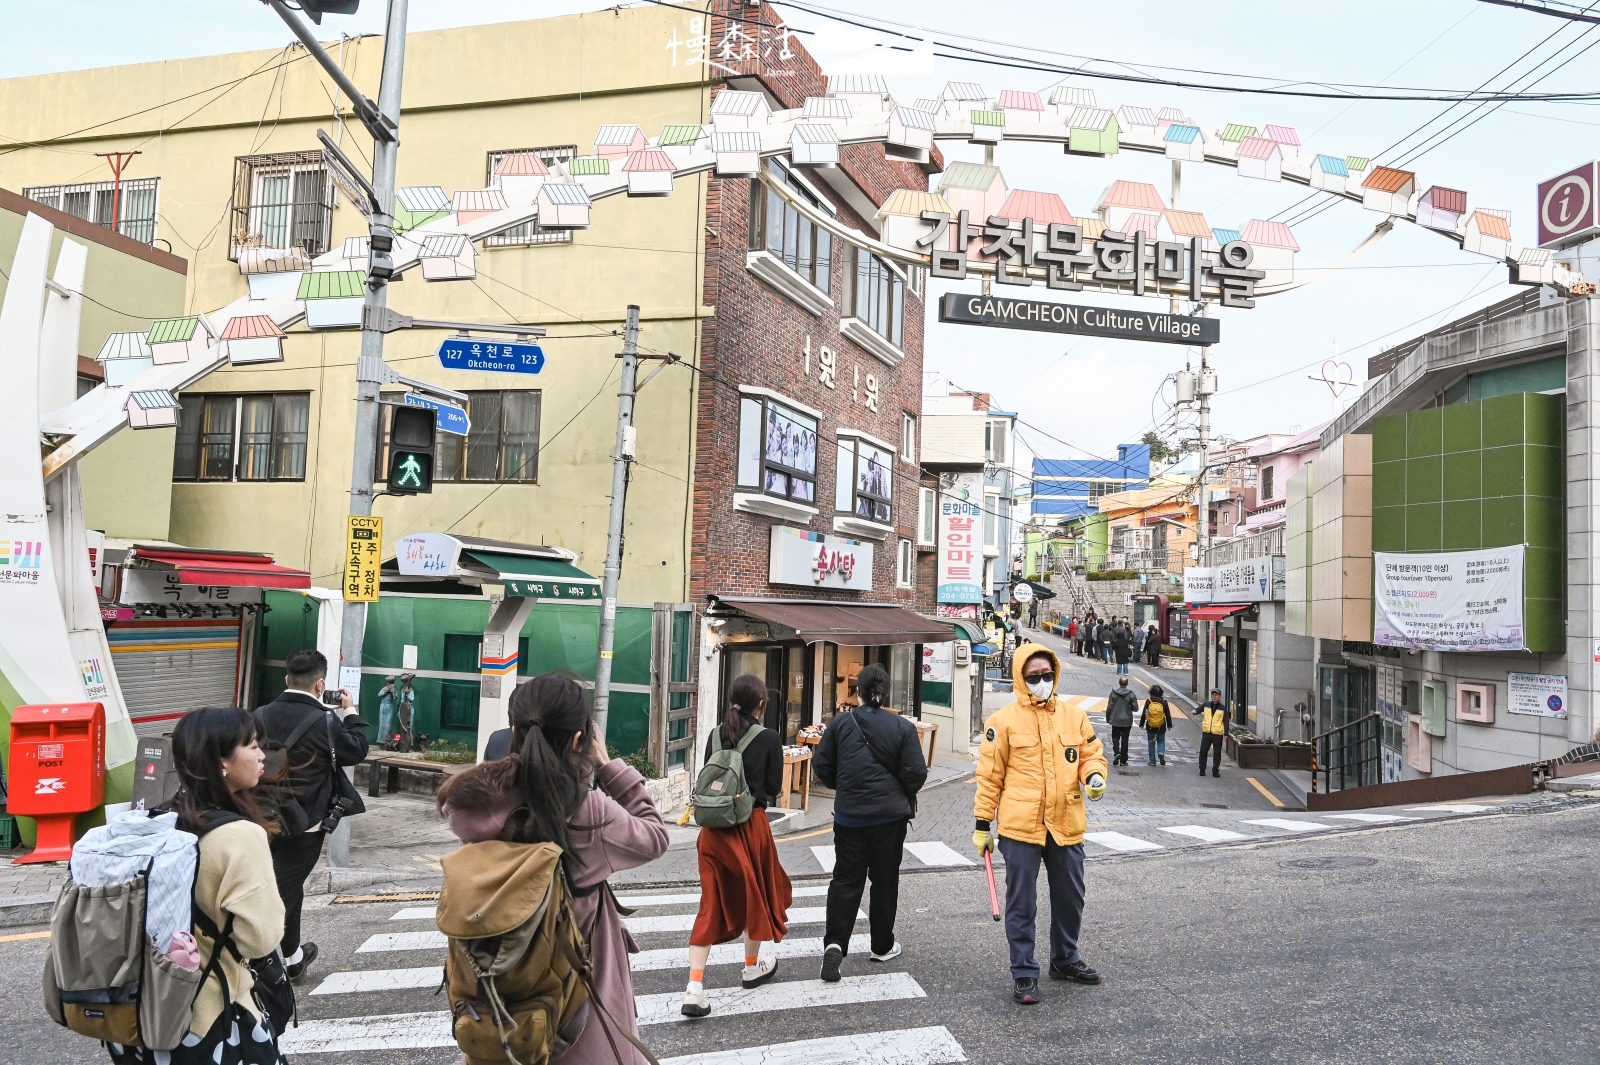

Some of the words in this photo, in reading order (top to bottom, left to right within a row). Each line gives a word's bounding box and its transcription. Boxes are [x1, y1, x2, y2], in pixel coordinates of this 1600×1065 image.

[916, 208, 1266, 308] 감천문화마을
[967, 297, 1079, 326] GAMCHEON
[1082, 308, 1144, 332] Culture
[1147, 315, 1202, 337] Village
[446, 349, 463, 360] 127
[470, 344, 514, 359] 옥천로
[468, 359, 515, 370] Okcheon-ro
[521, 354, 538, 365] 123
[942, 502, 981, 517] 문화마을
[351, 518, 379, 528] CCTV
[946, 516, 975, 580] 할인마트
[816, 545, 855, 581] 솜사탕
[1386, 563, 1398, 573] 단체
[1433, 564, 1449, 573] 이상)
[349, 542, 361, 598] 단속구역
[1386, 574, 1400, 582] Group
[945, 585, 977, 593] 신속배달
[941, 592, 980, 601] 204-0793
[38, 760, 64, 768] POST
